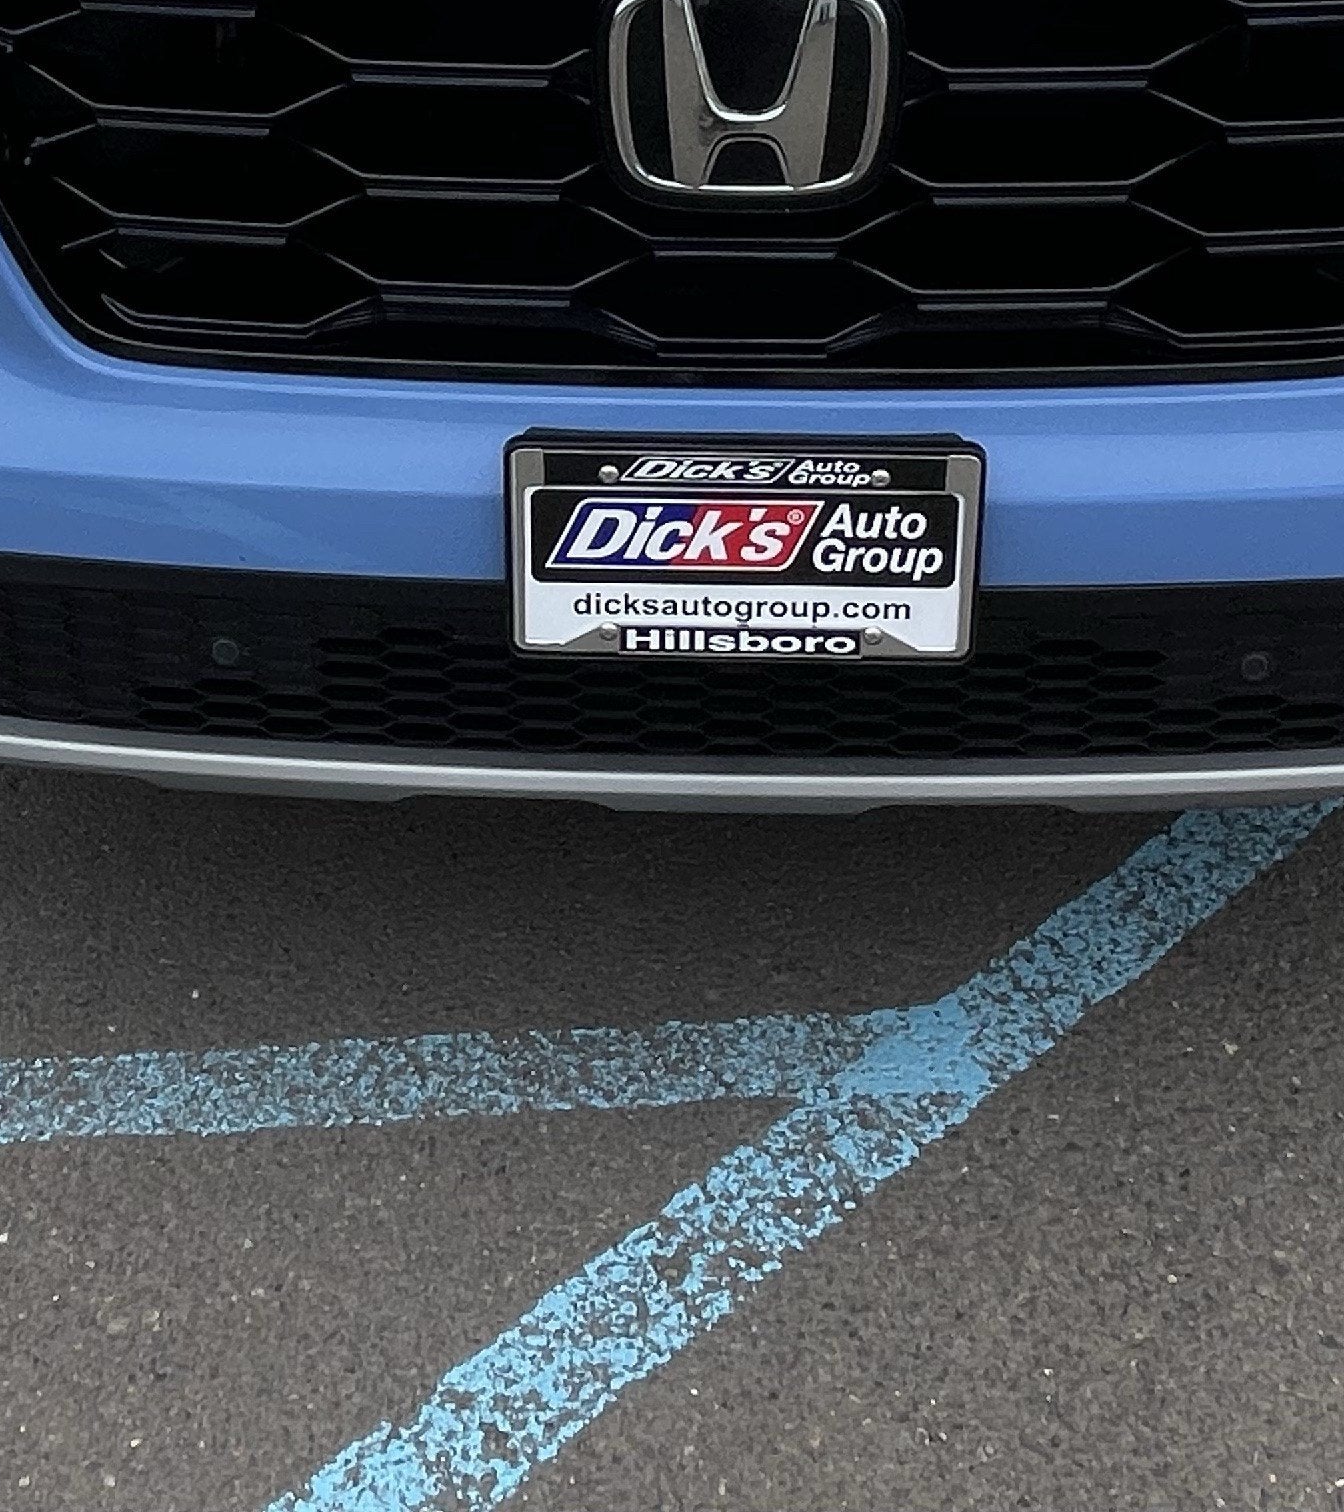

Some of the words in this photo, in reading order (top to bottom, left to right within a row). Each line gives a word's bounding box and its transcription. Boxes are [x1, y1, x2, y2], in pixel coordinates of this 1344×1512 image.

[633, 459, 775, 481] Dick's
[788, 472, 872, 488] Group
[793, 459, 861, 474] Auto
[566, 506, 791, 563] Dick's
[820, 503, 928, 540] Auto
[812, 538, 944, 581] Group
[573, 593, 911, 625] dicksautogroup.com
[625, 628, 857, 654] Hillsboro
